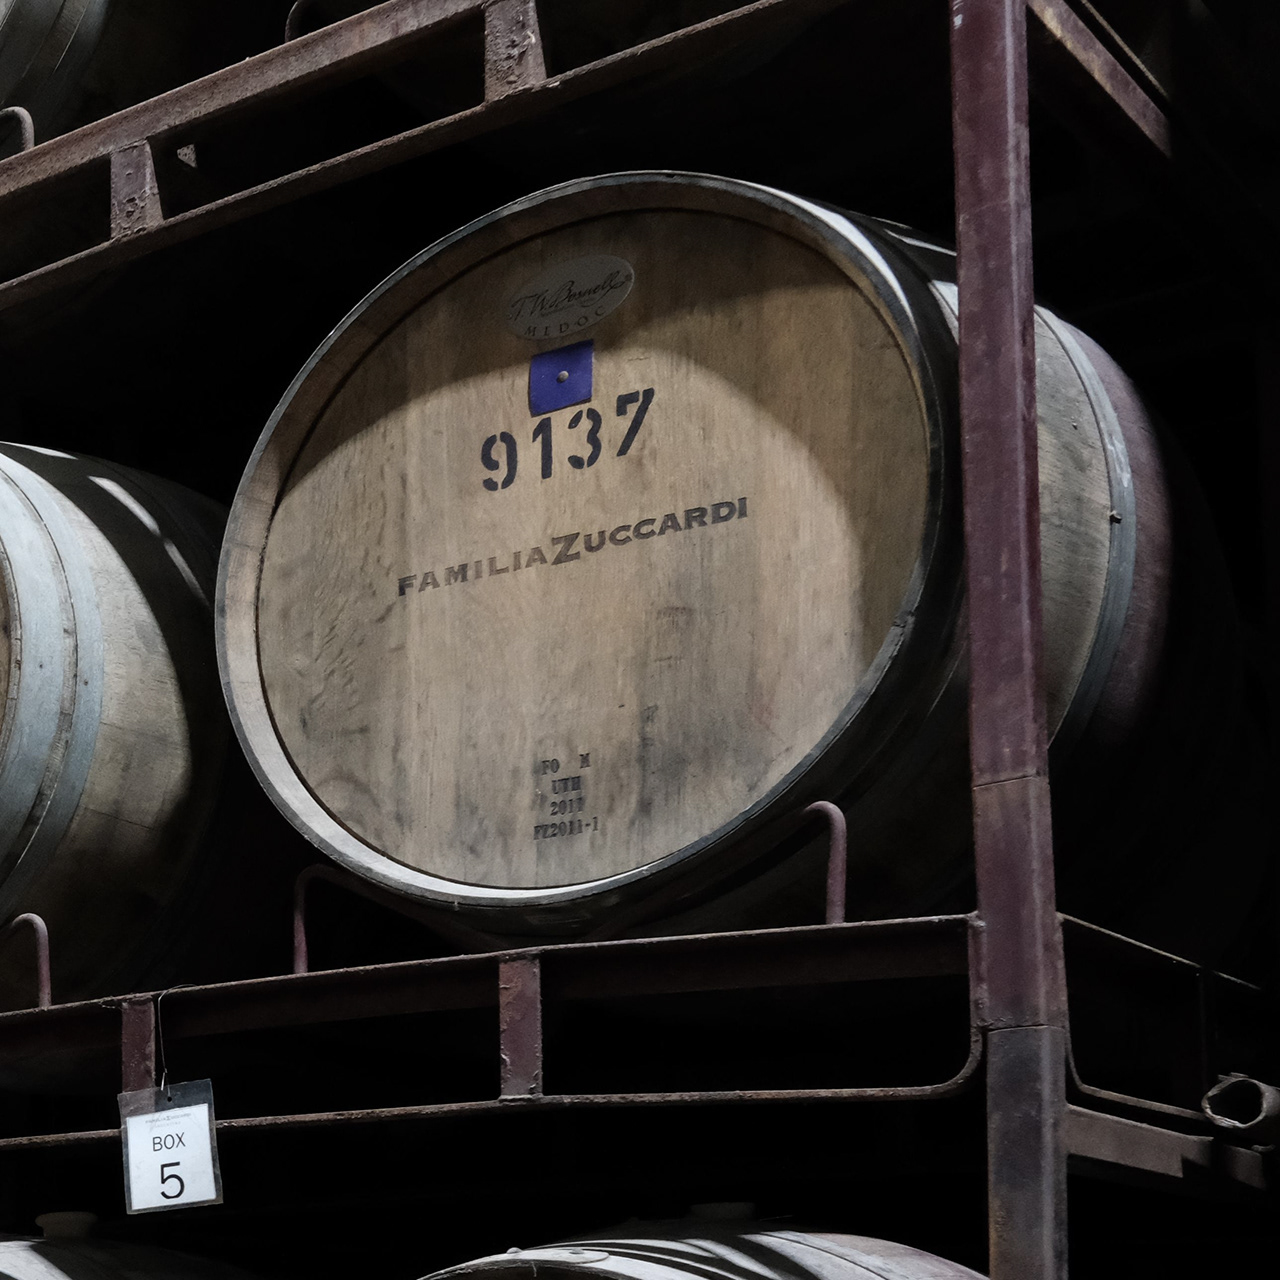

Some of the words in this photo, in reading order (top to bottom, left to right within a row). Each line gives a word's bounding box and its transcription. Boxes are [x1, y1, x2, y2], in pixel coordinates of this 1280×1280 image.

[480, 387, 655, 491] 9137
[397, 497, 748, 597] FAMILIAZUCCARDI
[153, 1132, 186, 1152] BOX
[160, 1161, 185, 1200] 5
